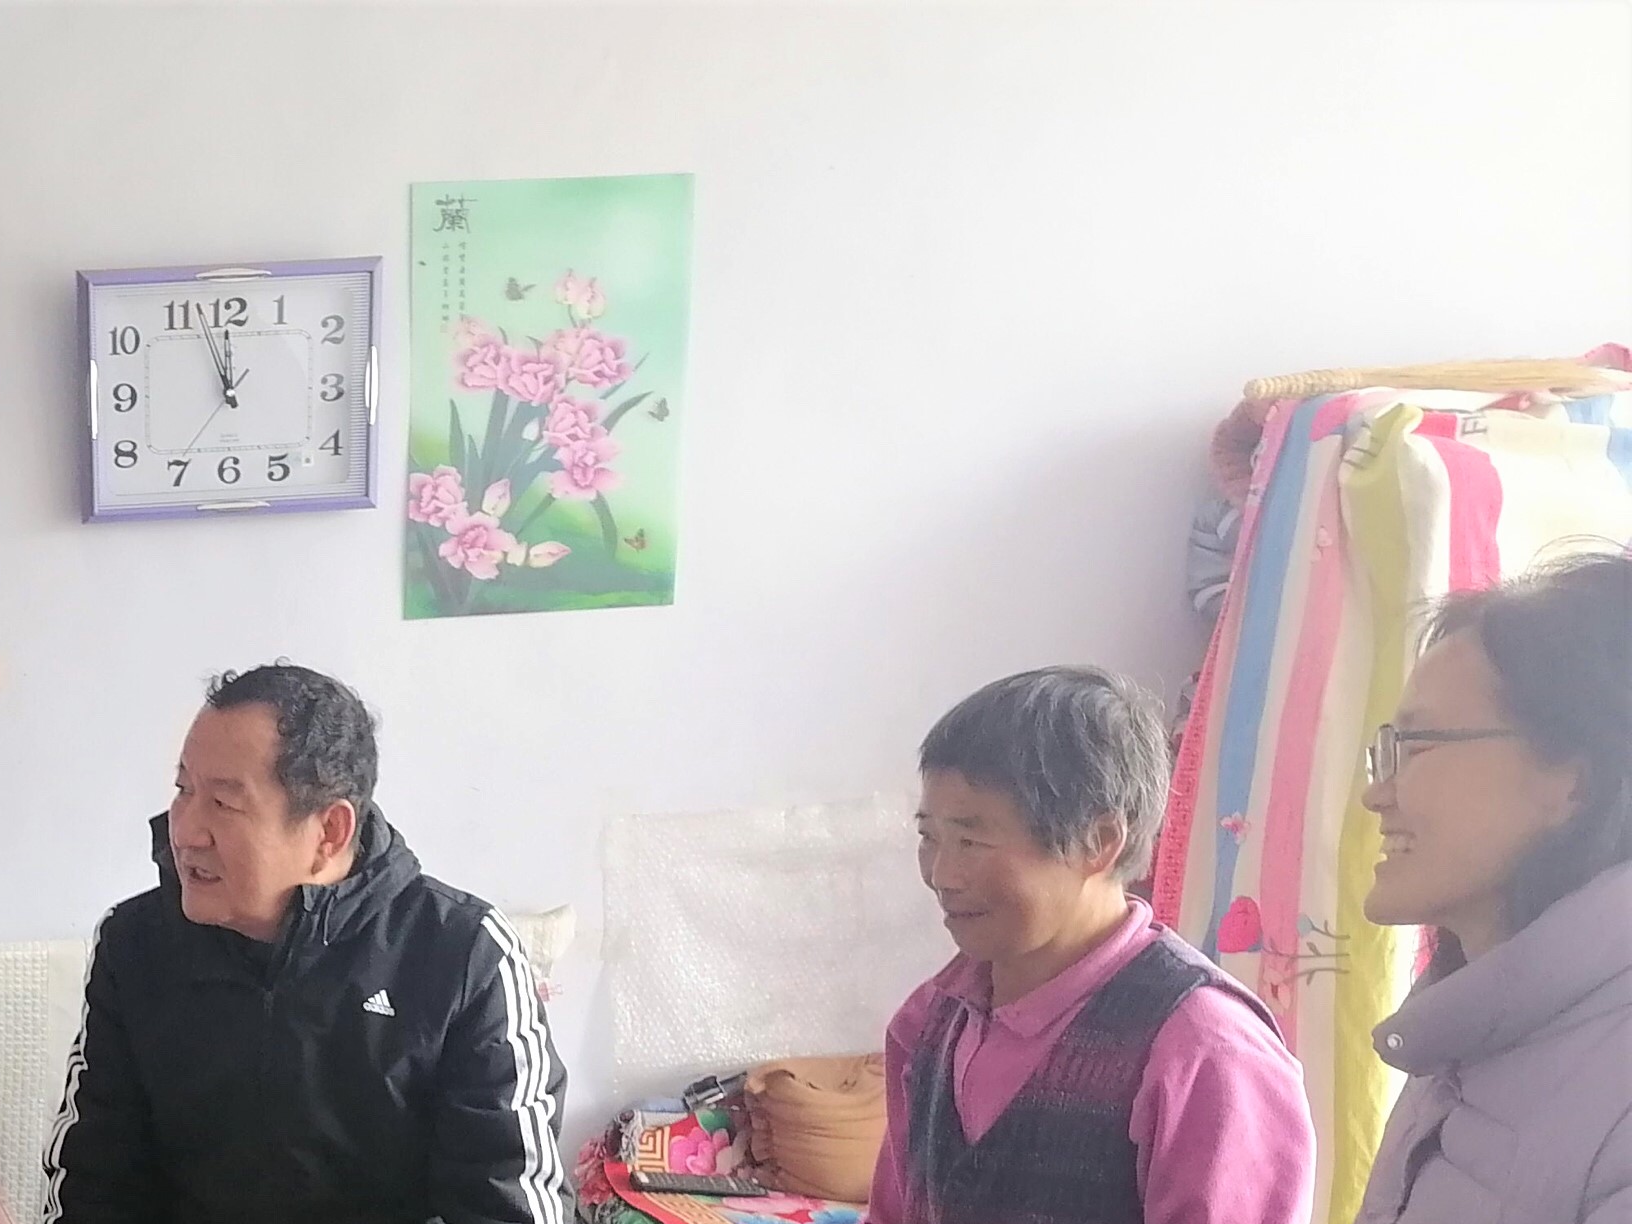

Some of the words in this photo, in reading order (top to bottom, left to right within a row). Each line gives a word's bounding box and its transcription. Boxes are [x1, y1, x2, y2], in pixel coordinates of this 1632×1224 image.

[163, 299, 194, 331] 11
[208, 296, 249, 329] 12
[272, 294, 288, 326] 1
[108, 325, 141, 356] 10
[320, 314, 346, 345] 2
[112, 382, 138, 413] 9
[320, 372, 345, 402] 3
[113, 439, 139, 469] 8
[318, 428, 344, 456] 4
[167, 457, 192, 487] 7
[217, 455, 241, 485] 6
[267, 453, 291, 482] 5
